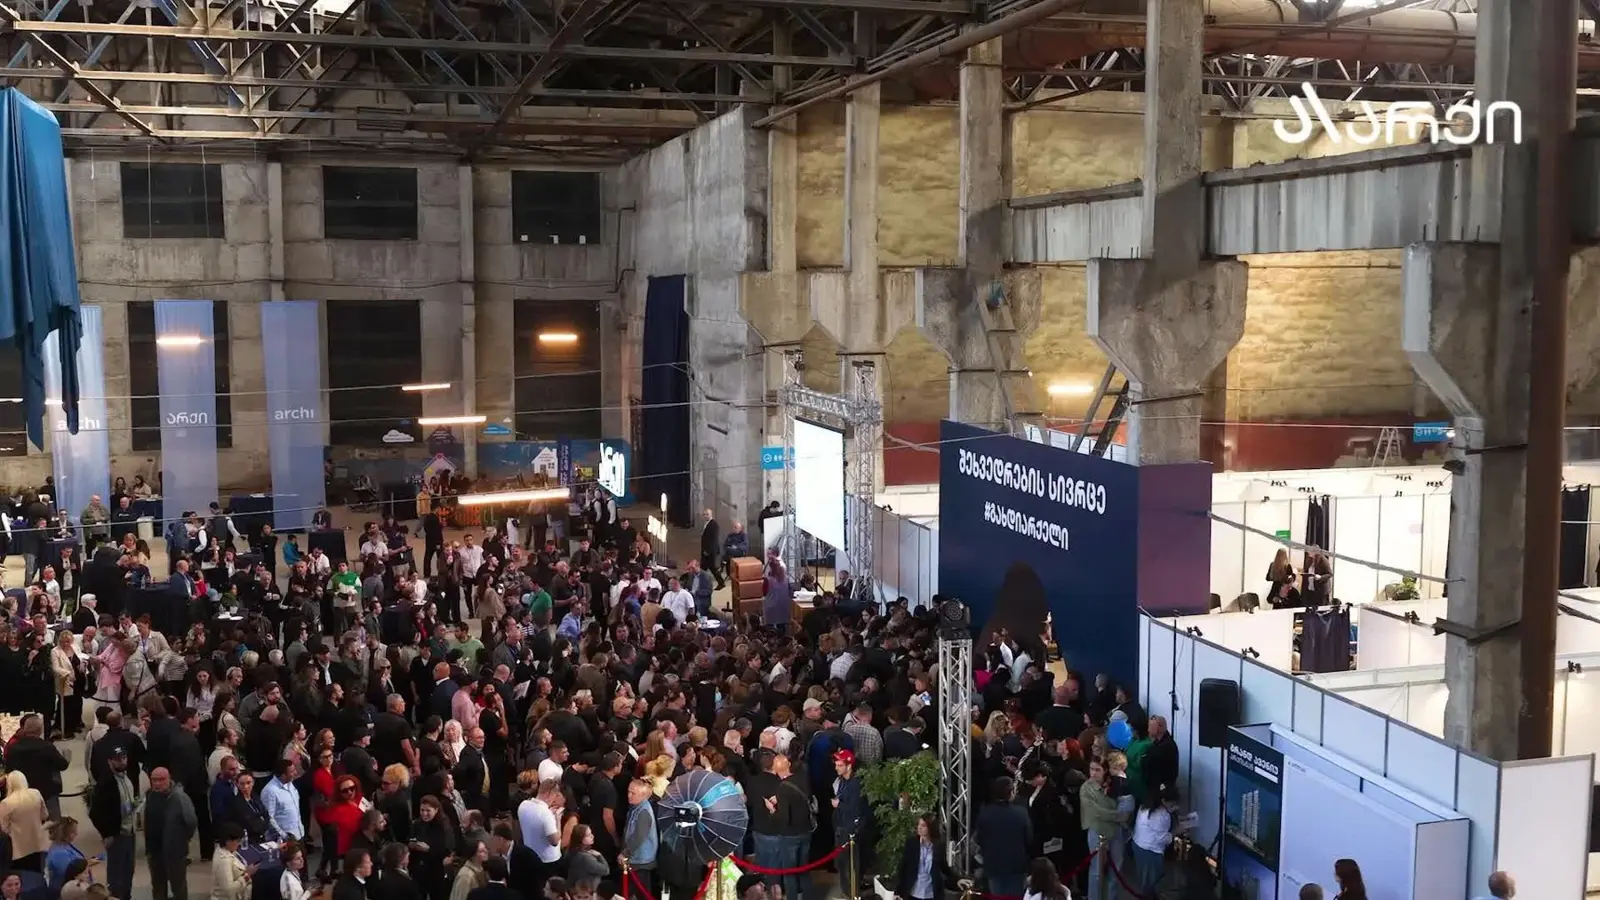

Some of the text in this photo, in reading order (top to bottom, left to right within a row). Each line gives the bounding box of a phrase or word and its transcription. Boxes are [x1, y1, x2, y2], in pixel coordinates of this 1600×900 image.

[166, 411, 208, 424] არქი
[274, 406, 314, 420] archi
[57, 416, 100, 430] achi
[959, 448, 1106, 515] შეხვედრების სივრცე
[984, 501, 1069, 550] #გახდიარქელი
